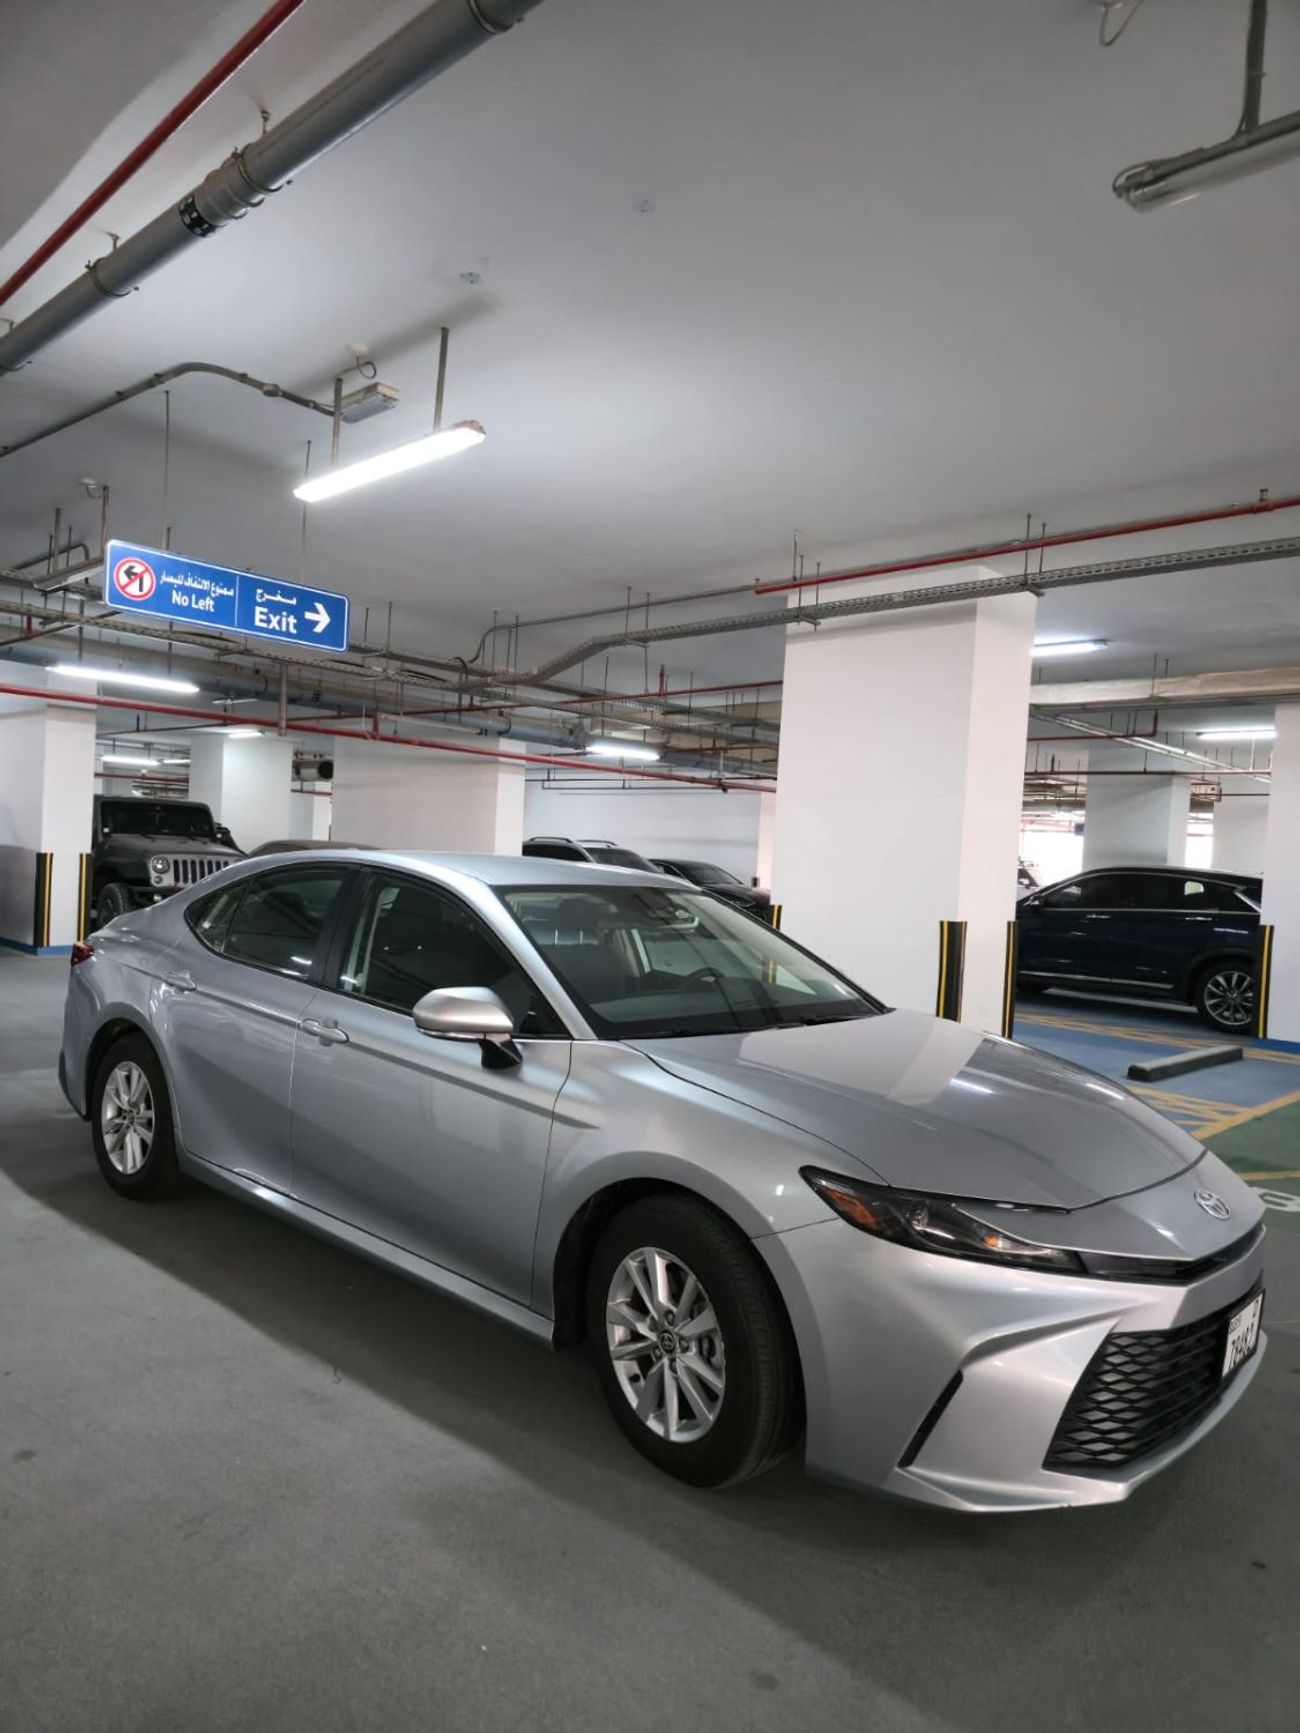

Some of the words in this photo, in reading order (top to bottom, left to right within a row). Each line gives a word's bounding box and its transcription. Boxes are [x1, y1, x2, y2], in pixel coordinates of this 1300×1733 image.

[210, 582, 234, 598] ممنوع
[255, 588, 297, 605] مخرج
[172, 589, 189, 606] No
[192, 593, 215, 612] Left
[254, 605, 297, 634] Exit
